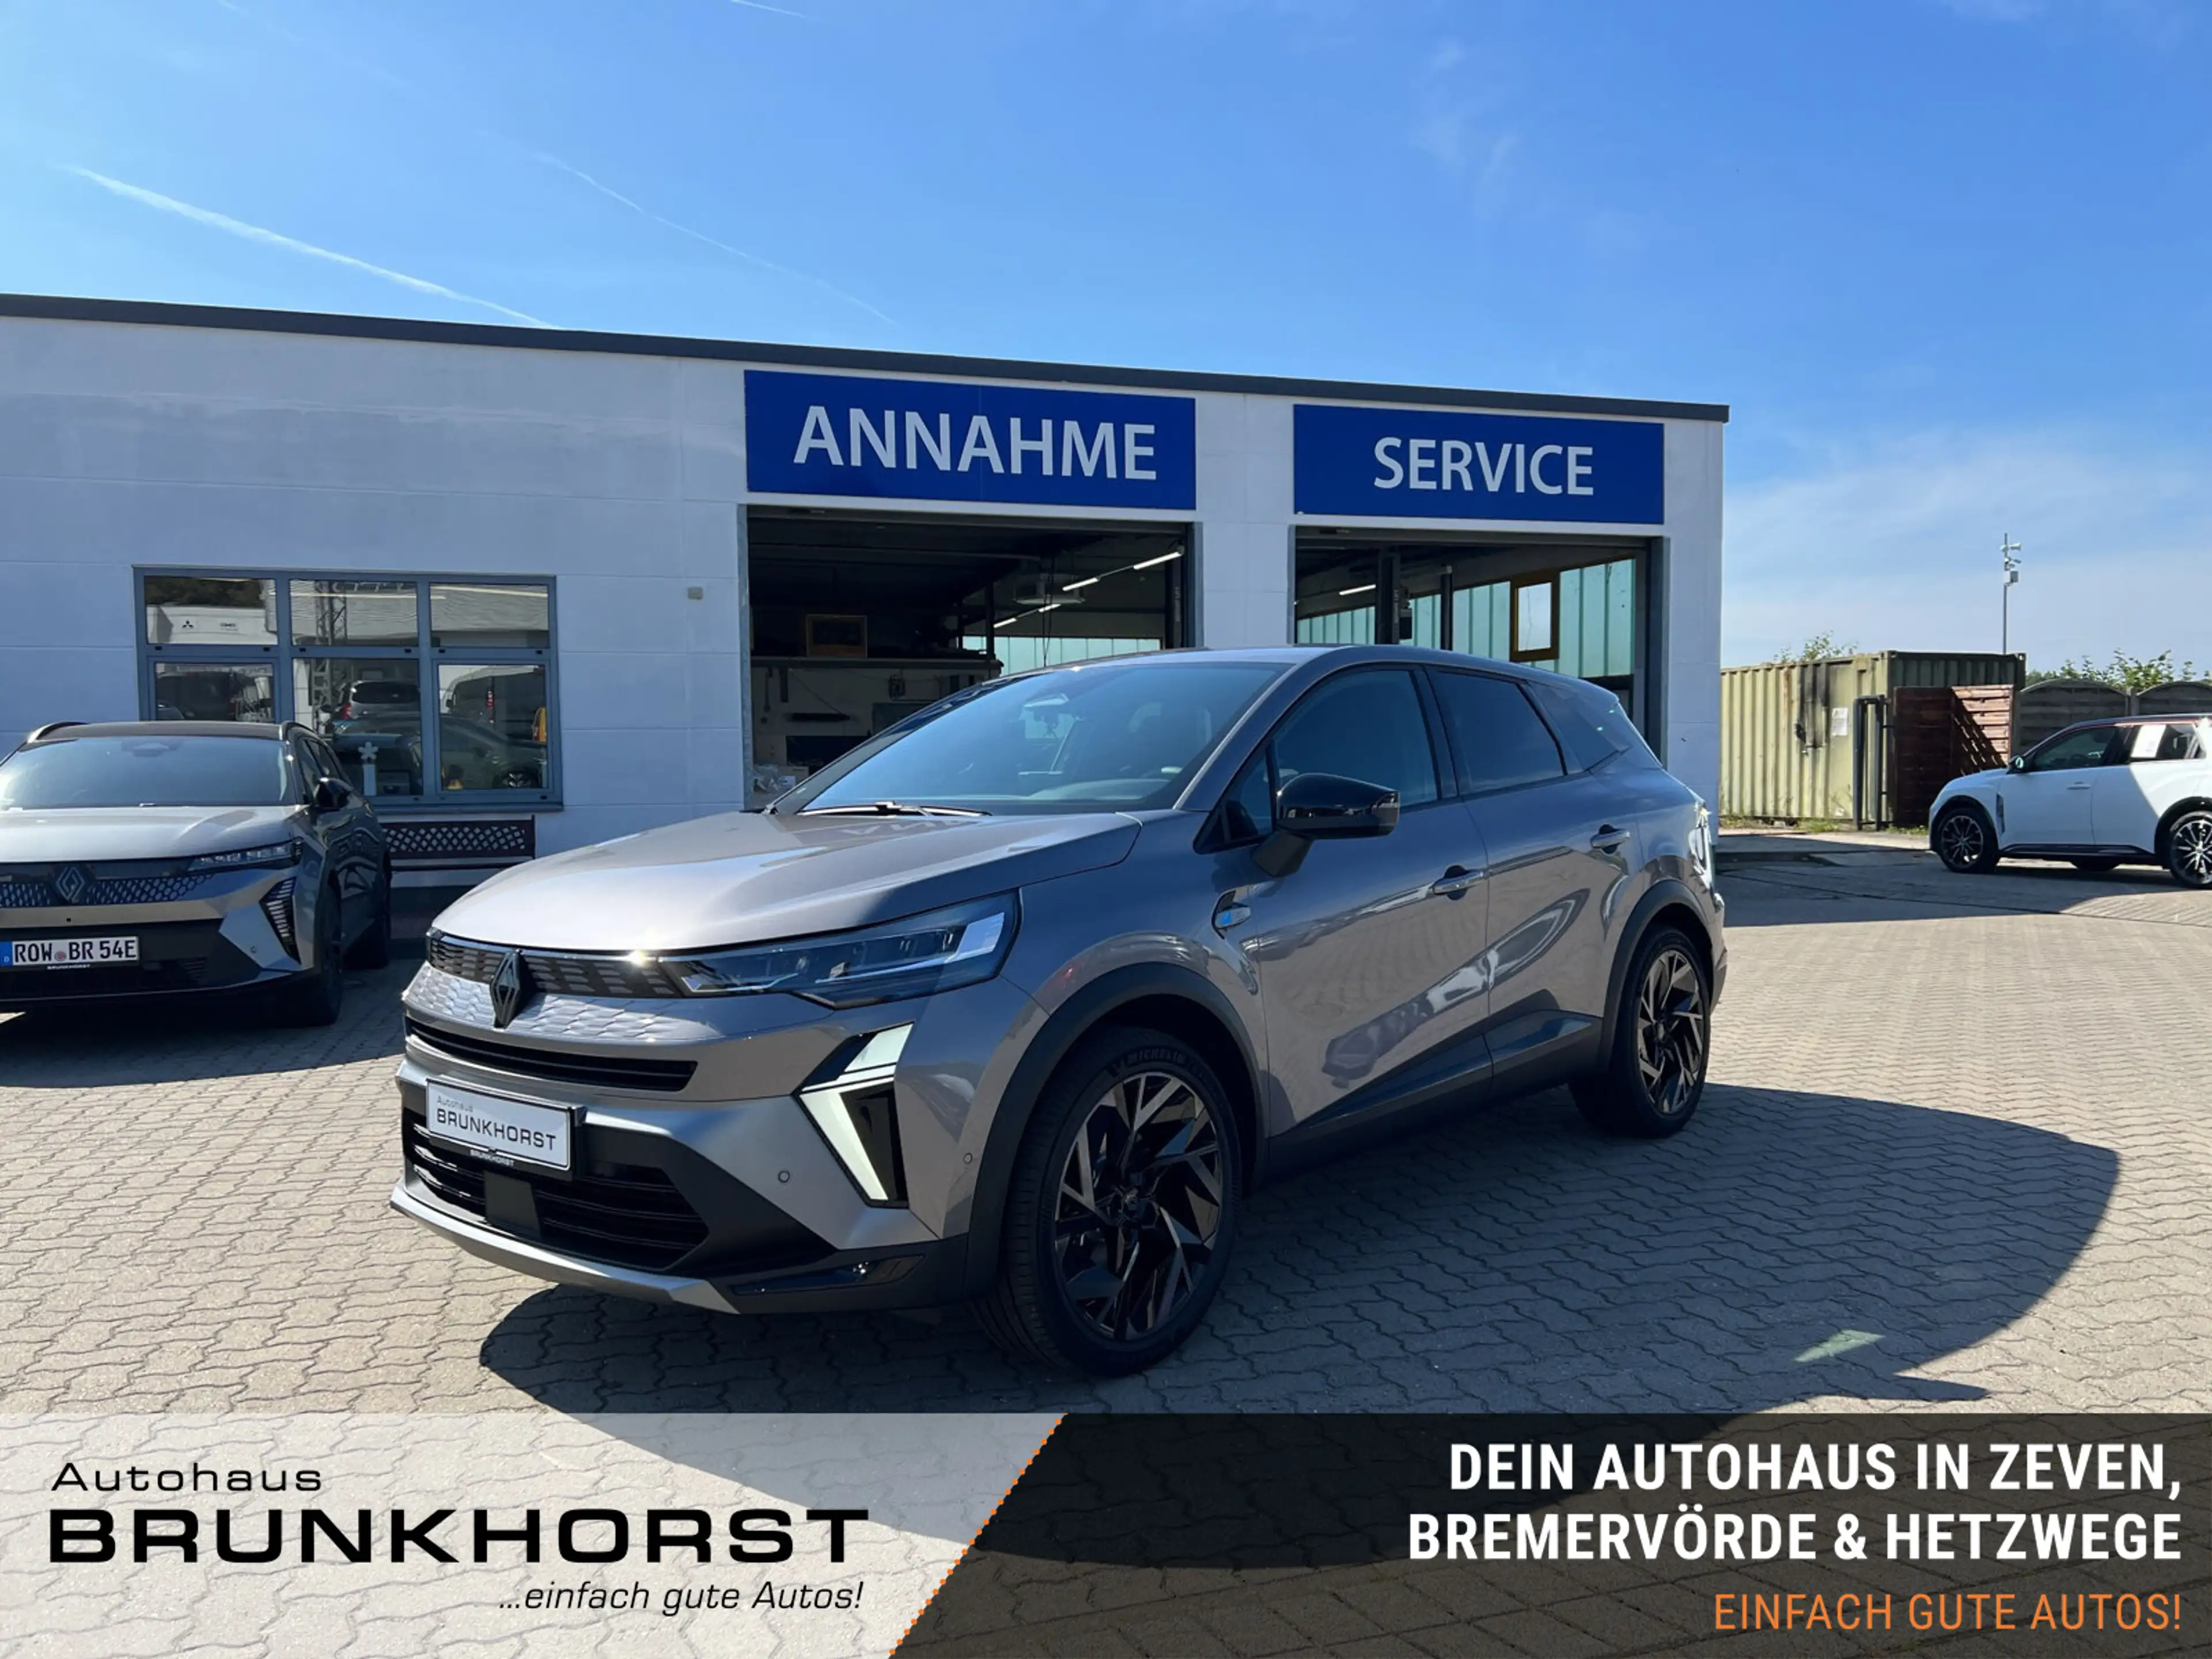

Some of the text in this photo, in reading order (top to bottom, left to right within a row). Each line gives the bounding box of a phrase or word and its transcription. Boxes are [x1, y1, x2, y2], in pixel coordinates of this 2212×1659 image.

[793, 405, 1157, 480] ANNAHME
[1374, 437, 1594, 496] SERVICE
[14, 940, 137, 963] ROW BR 54E
[436, 1108, 556, 1150] BRUNKHORST
